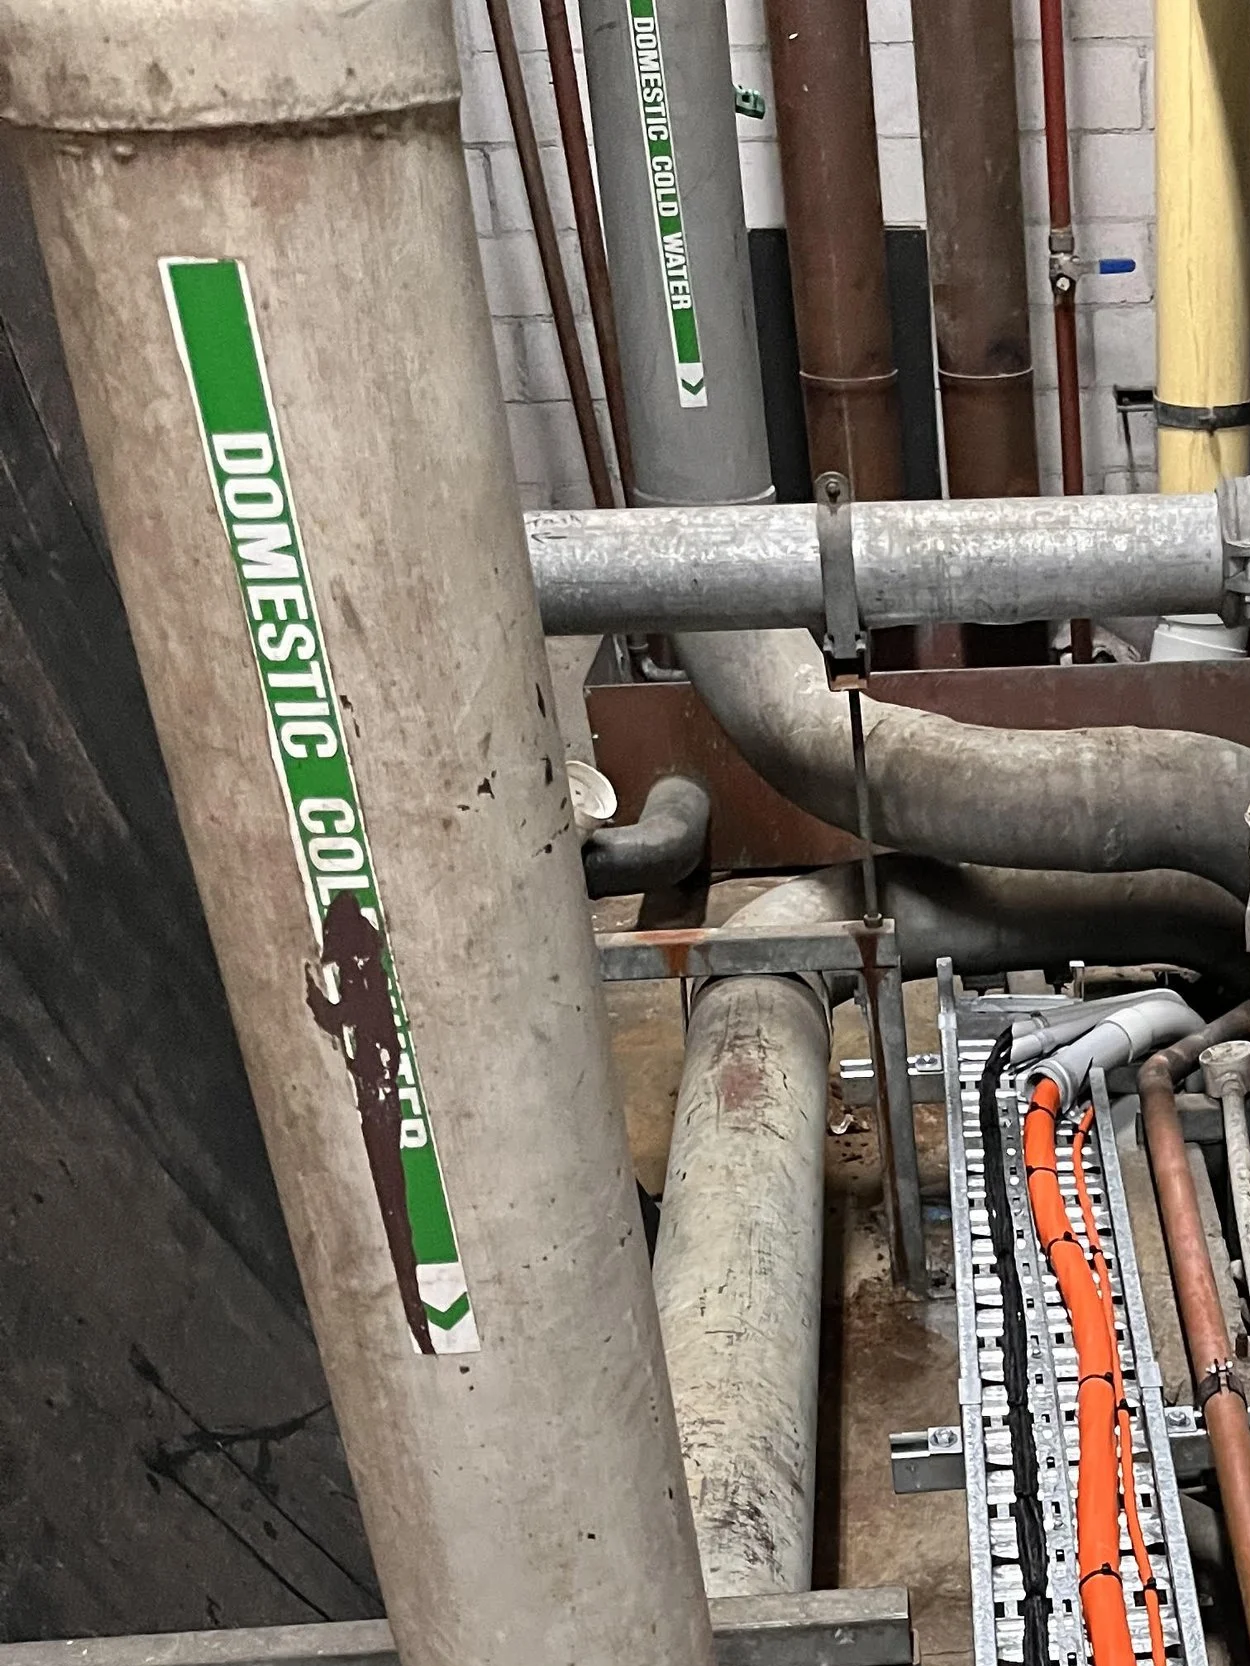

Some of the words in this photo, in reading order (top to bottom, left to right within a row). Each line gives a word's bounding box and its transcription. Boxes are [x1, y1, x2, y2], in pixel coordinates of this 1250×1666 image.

[633, 16, 668, 142] DOMESTIC
[651, 155, 680, 218] COLD
[662, 231, 692, 311] WATER
[211, 432, 338, 759] DOMESTIC
[299, 797, 379, 932] COL
